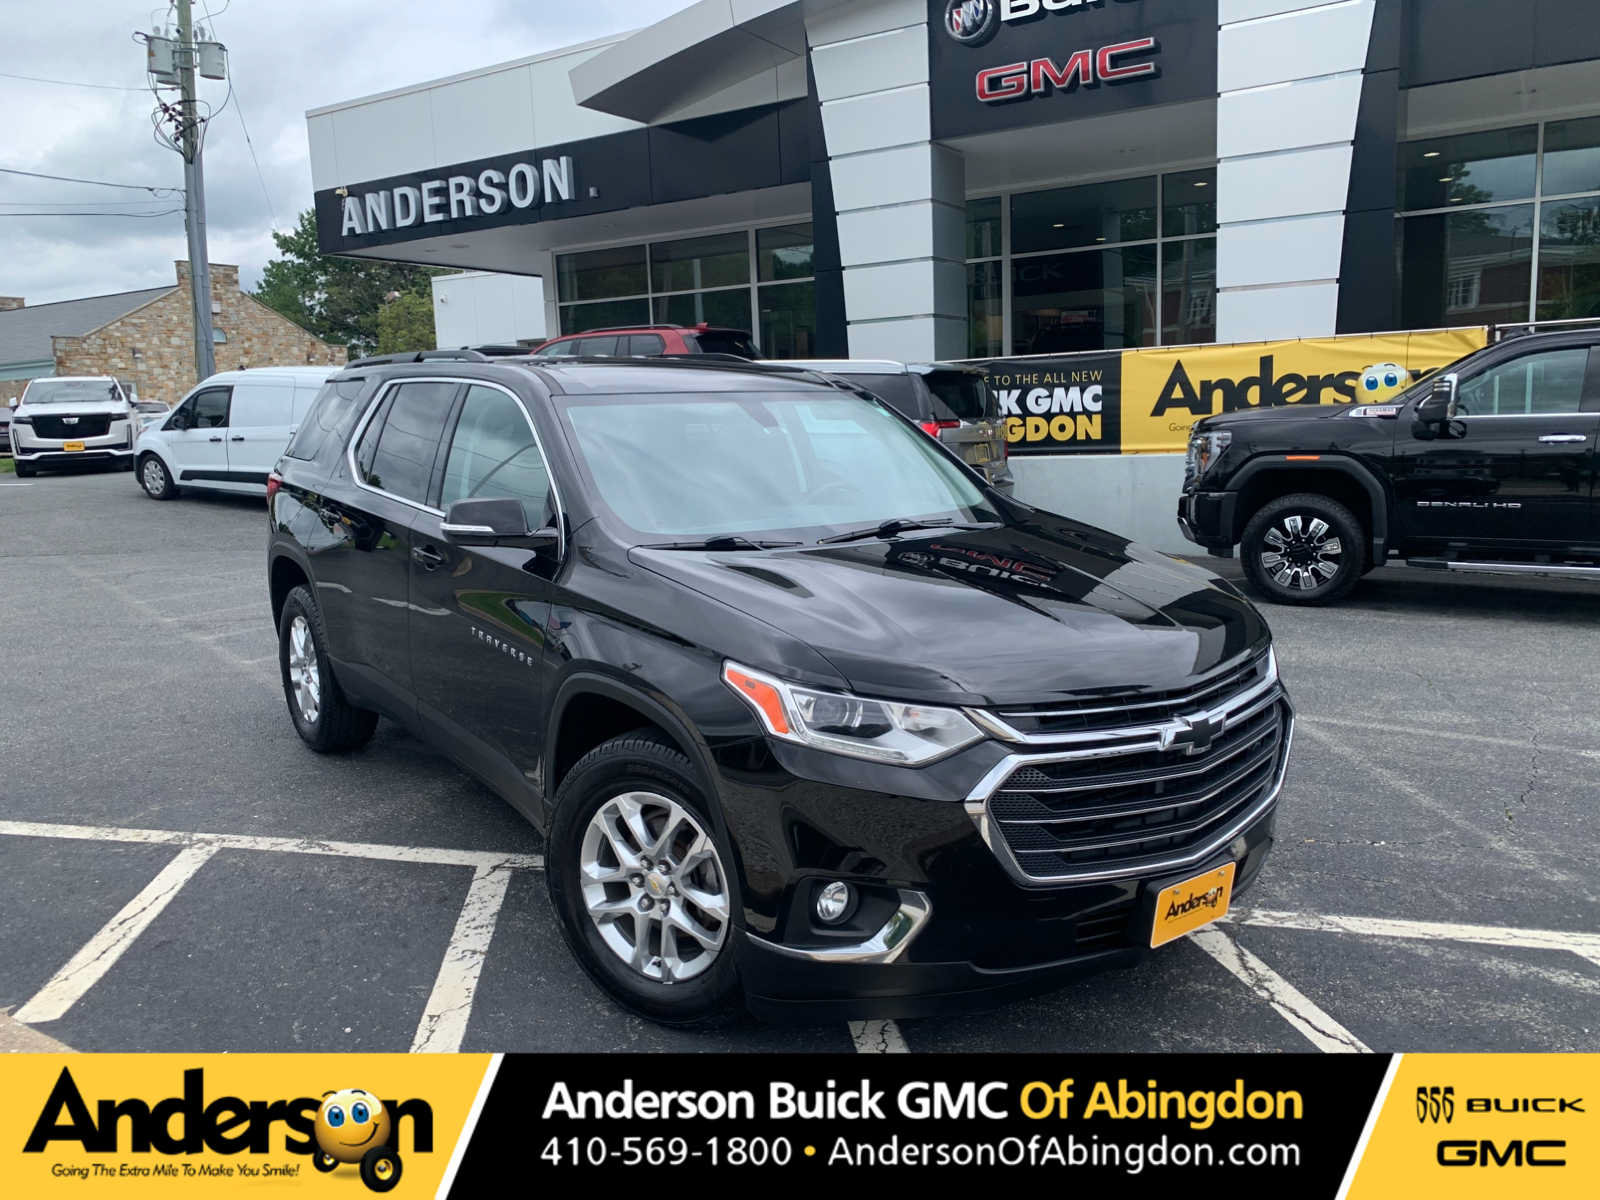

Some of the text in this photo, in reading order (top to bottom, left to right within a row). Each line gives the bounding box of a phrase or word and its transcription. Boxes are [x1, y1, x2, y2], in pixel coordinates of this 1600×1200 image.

[976, 37, 1155, 102] GMC
[341, 156, 575, 236] ANDERSON
[994, 375, 1011, 386] TO
[1015, 373, 1039, 385] THE
[1043, 371, 1067, 384] ALL
[1071, 369, 1103, 382] NEW
[1026, 384, 1103, 414] GMC
[1006, 414, 1102, 443] GDON
[471, 626, 534, 667] TRAVERSE
